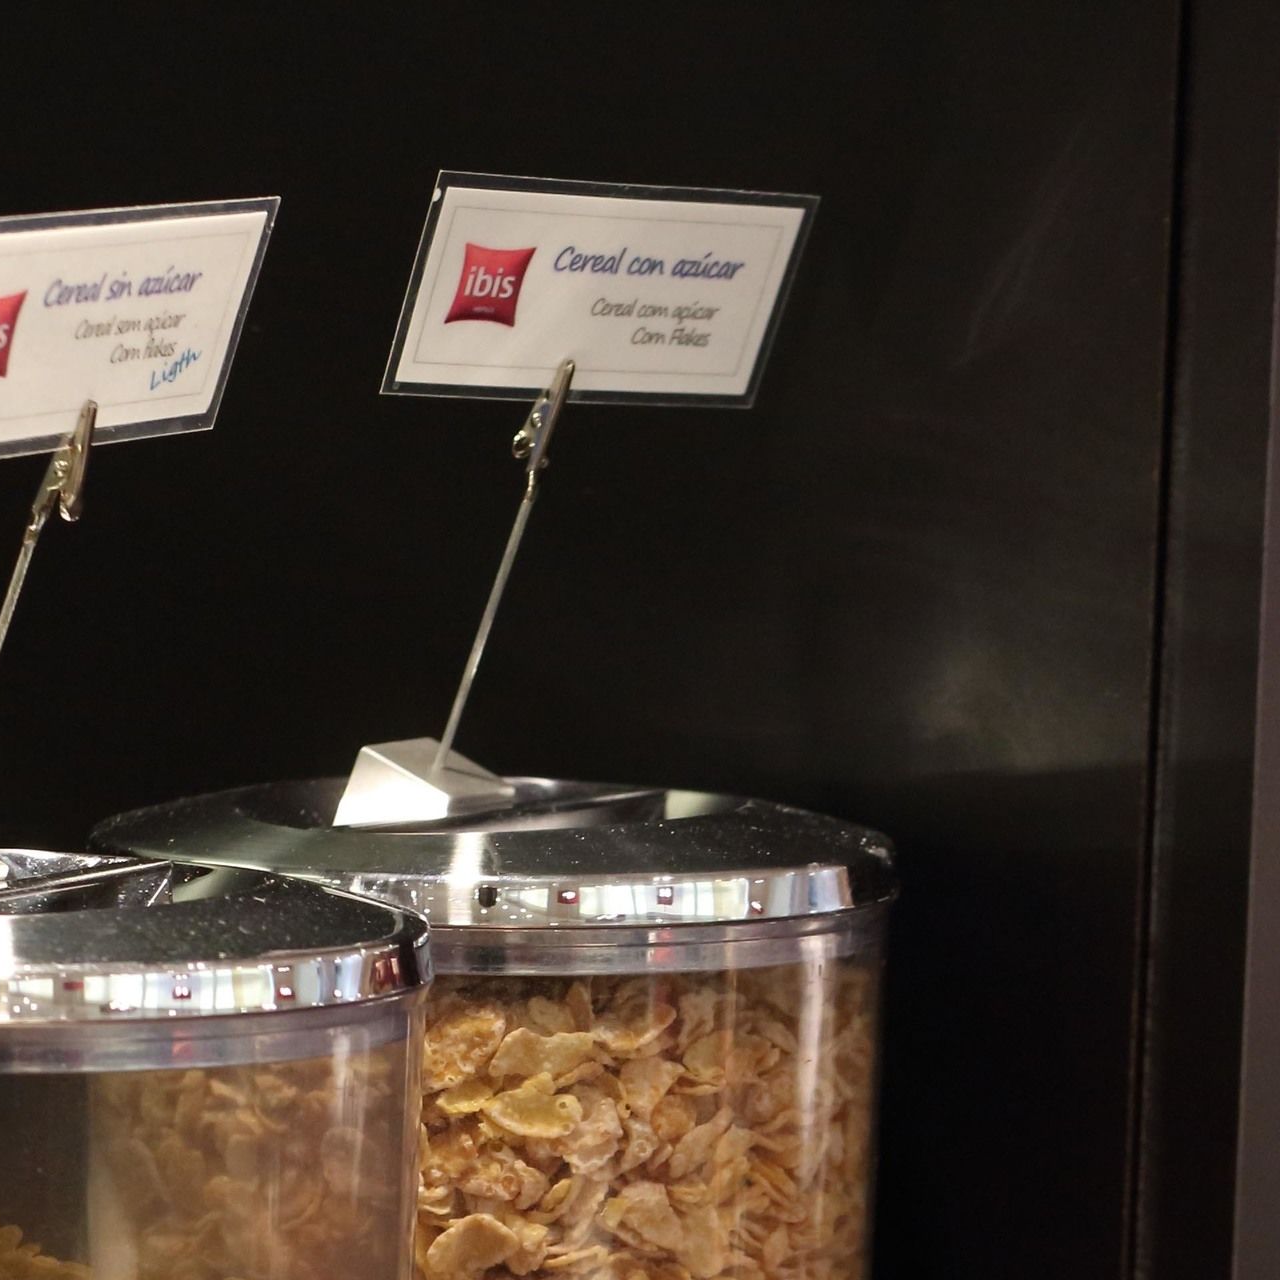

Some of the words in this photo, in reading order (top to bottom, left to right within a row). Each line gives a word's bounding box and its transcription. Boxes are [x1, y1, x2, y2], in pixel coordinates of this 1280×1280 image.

[554, 246, 627, 275] Cereal
[627, 255, 664, 276] con
[672, 251, 745, 280] azúcar
[43, 272, 108, 307] Cereal
[105, 270, 132, 301] sin
[138, 265, 203, 296] azúcar
[463, 265, 516, 299] ibis
[591, 297, 640, 318] Cereal
